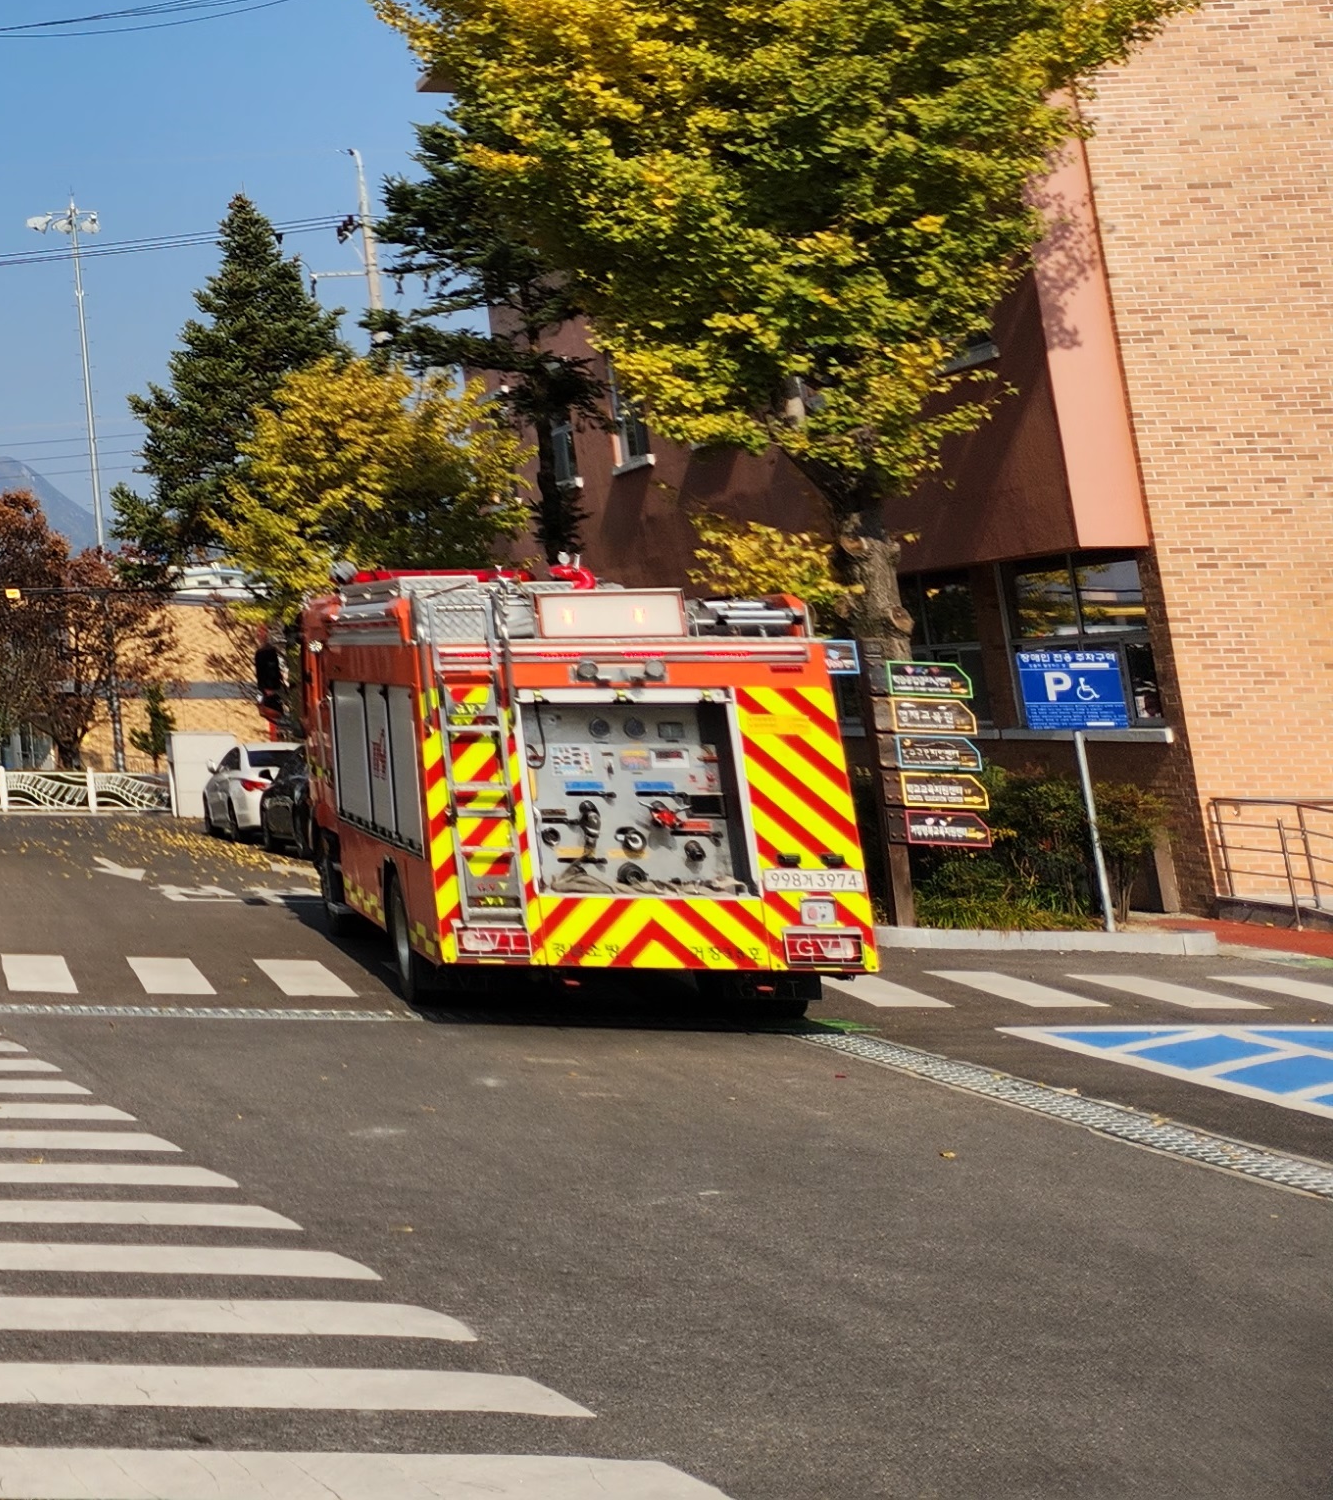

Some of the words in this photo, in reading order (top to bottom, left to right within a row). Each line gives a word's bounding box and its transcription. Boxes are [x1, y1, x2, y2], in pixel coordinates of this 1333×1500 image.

[1020, 653, 1050, 663] 장애인
[1053, 653, 1072, 663] 전용
[1075, 653, 1115, 662] 주차구역
[1044, 672, 1072, 701] P
[771, 873, 813, 889] 998거
[817, 873, 858, 888] 3974
